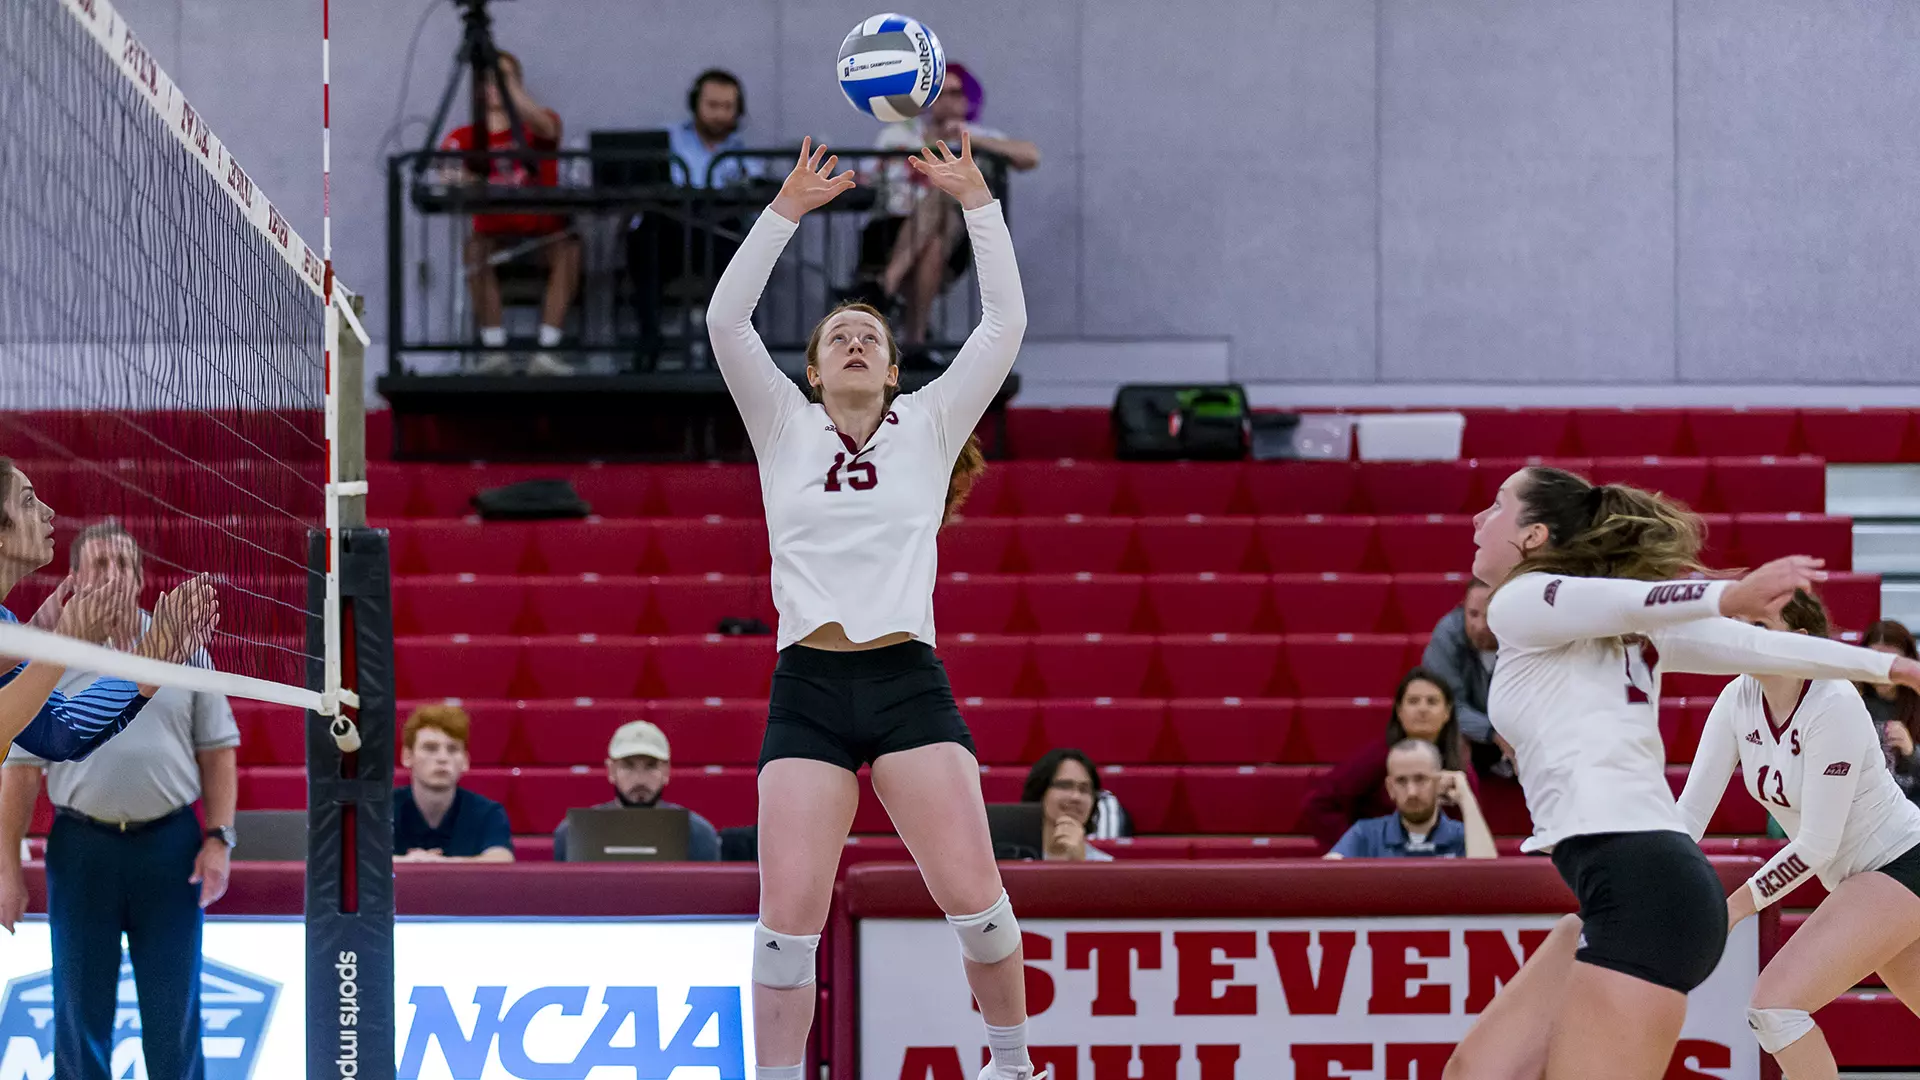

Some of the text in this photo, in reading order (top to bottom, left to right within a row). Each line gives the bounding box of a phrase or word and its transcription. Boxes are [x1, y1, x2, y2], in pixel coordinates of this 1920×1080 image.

[915, 32, 932, 91] molten
[824, 452, 878, 492] 15
[1644, 582, 1709, 606] DUCKS
[1790, 728, 1801, 757] S
[1757, 765, 1791, 808] 13
[1755, 852, 1809, 897] DUCKS
[972, 930, 1553, 1016] STEVEN
[334, 951, 361, 1080] sports imp
[394, 985, 746, 1080] NCAA
